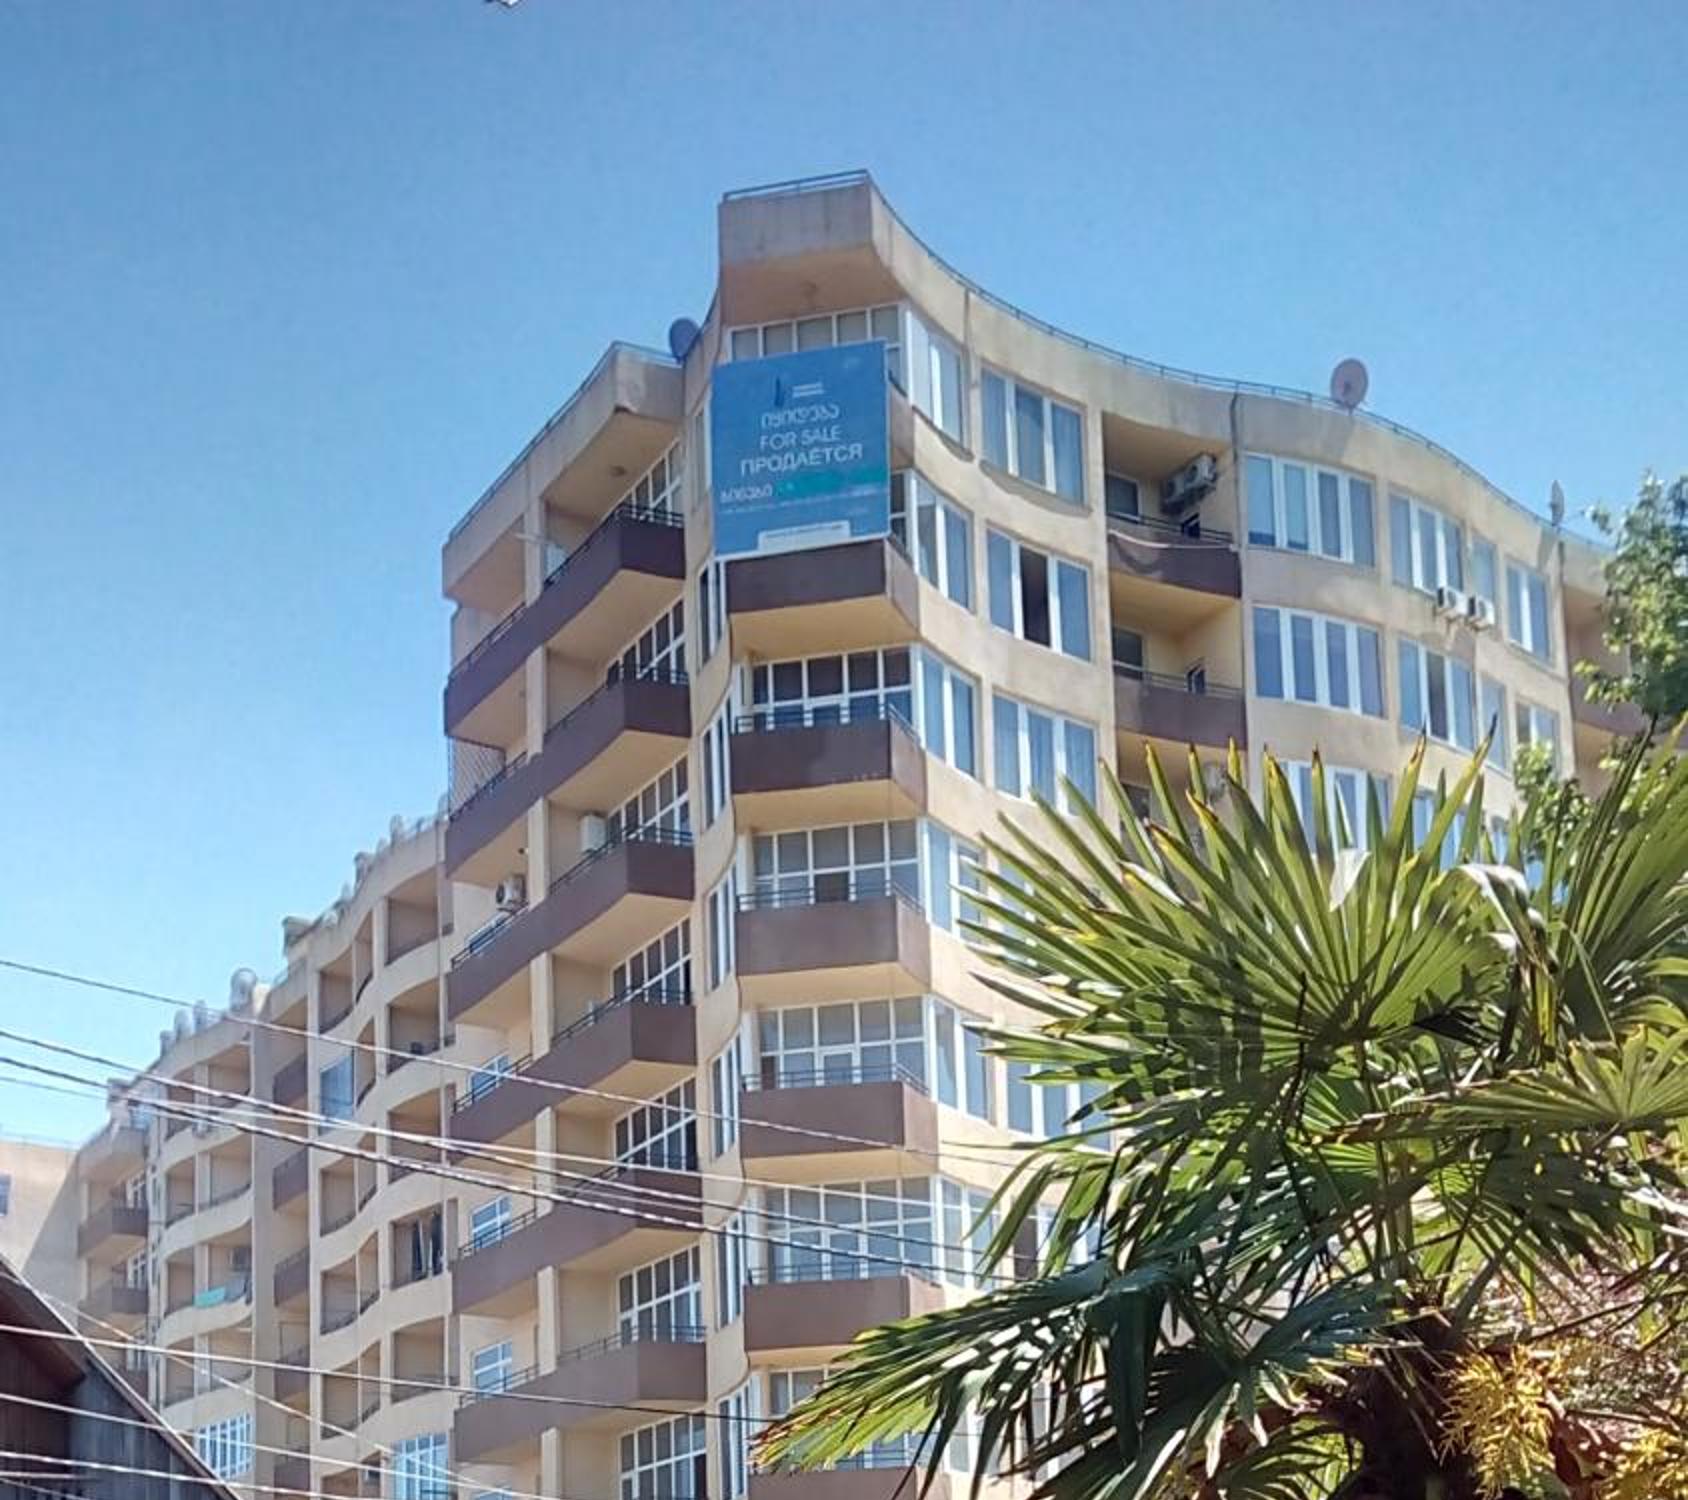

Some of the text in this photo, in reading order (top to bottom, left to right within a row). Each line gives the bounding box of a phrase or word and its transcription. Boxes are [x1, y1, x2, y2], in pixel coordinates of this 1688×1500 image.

[760, 425, 842, 450] FOR SALE
[740, 443, 864, 477] ПРОДАЕТСЯ
